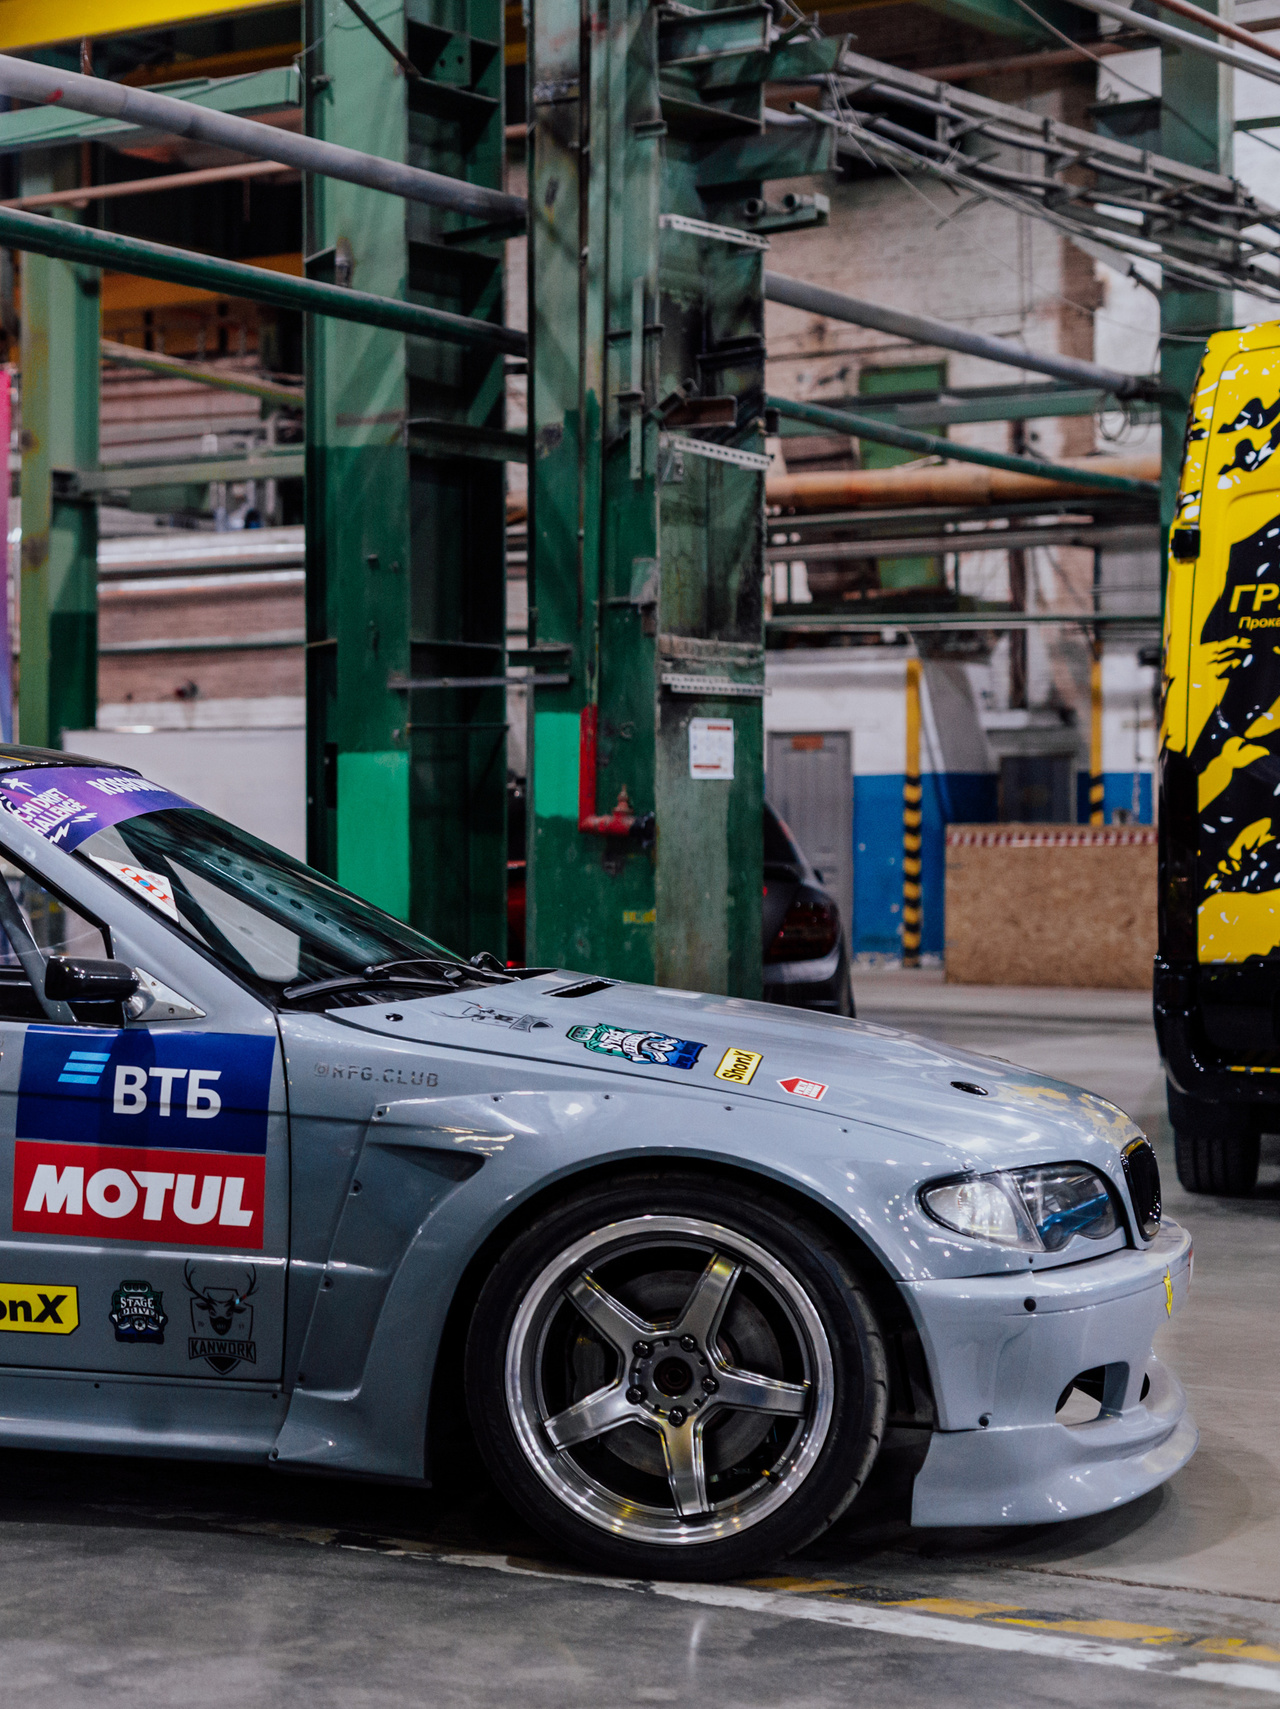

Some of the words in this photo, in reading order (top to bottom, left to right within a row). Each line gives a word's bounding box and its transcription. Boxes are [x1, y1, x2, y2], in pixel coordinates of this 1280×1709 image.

[1229, 582, 1280, 613] ГР
[30, 787, 69, 809] DRIFT
[28, 798, 87, 837] HALLENGE
[722, 1050, 755, 1081] ShonX
[113, 1065, 222, 1119] ВТБ
[23, 1163, 254, 1227] MOTUL
[120, 1296, 155, 1309] STAGE
[191, 1340, 254, 1360] KANWORK
